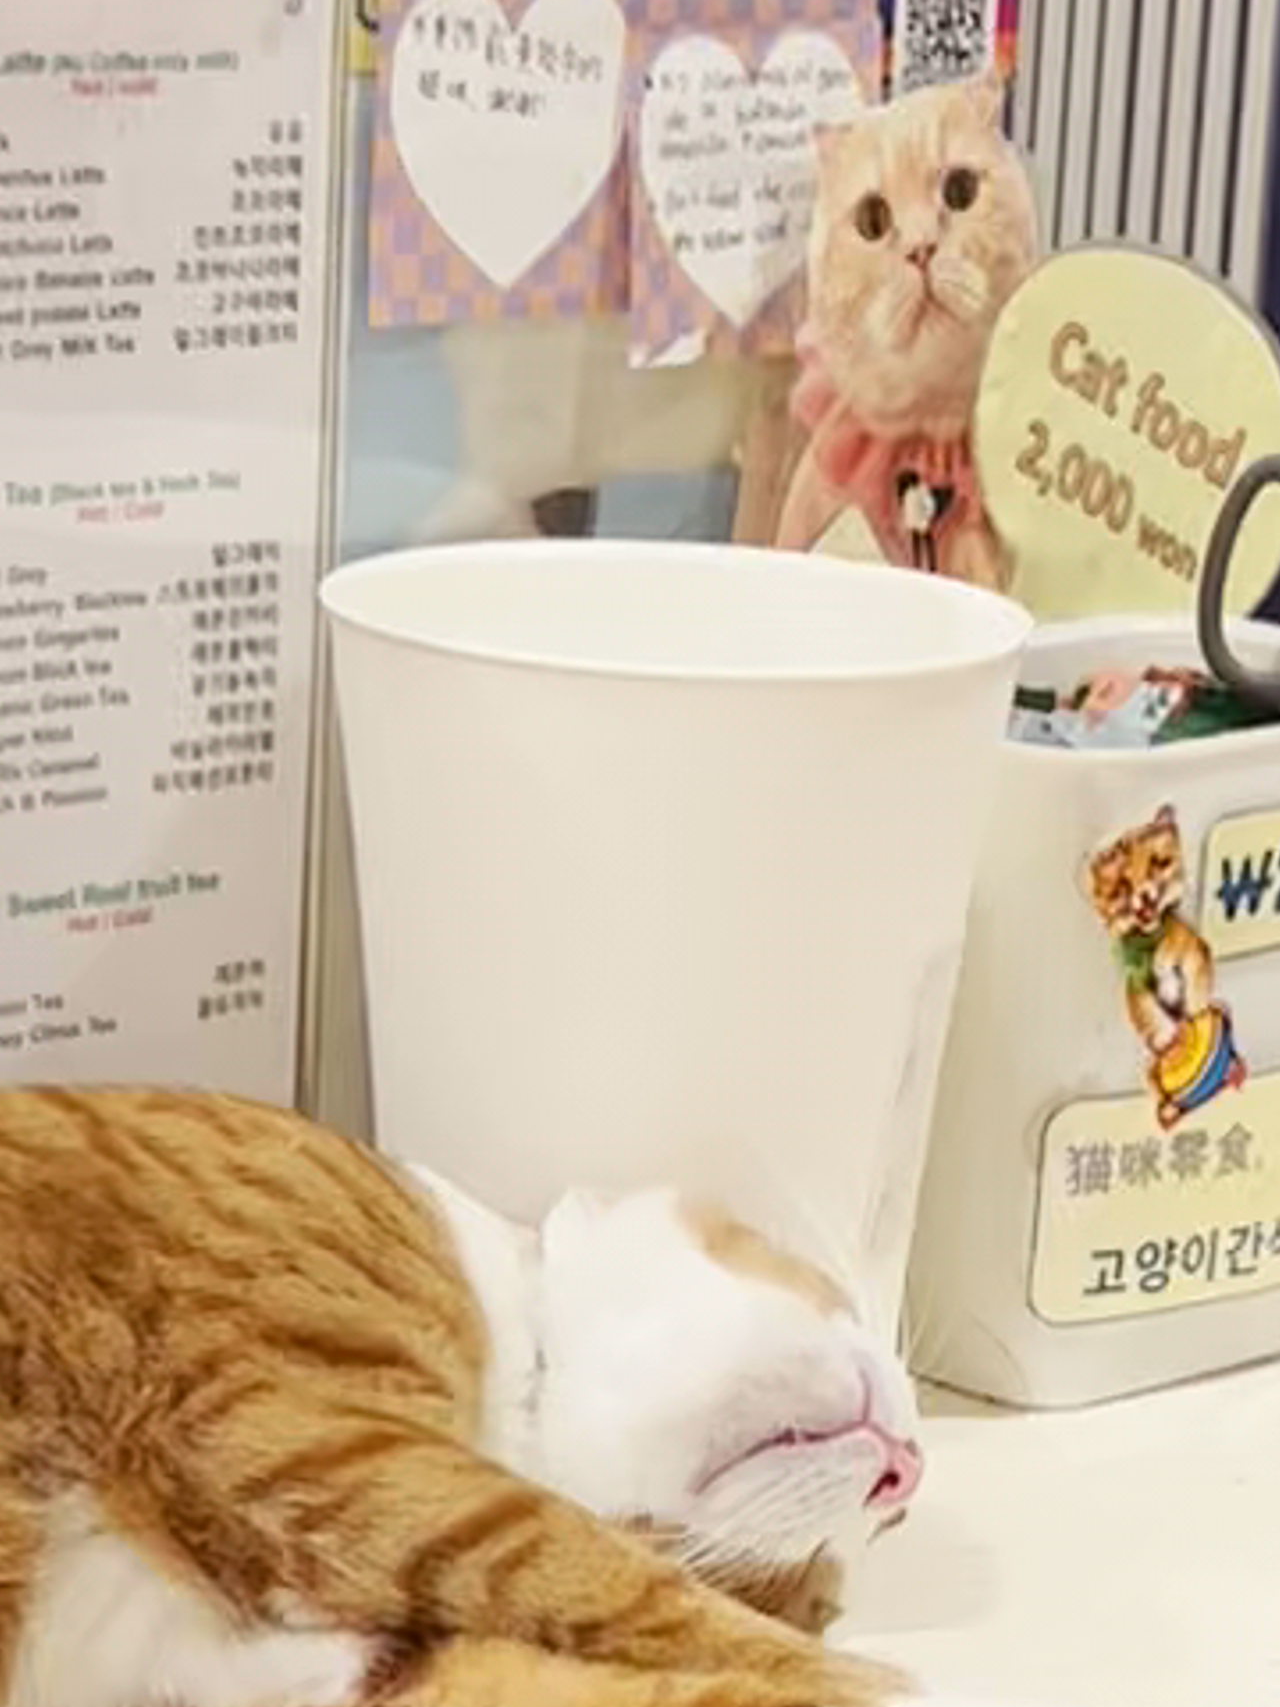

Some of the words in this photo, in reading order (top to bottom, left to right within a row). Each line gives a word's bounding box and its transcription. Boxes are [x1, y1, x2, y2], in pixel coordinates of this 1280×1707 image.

[33, 202, 81, 222] Latte
[60, 166, 106, 185] Latte
[1050, 321, 1128, 419] Cat
[1130, 371, 1247, 492] food
[1015, 419, 1135, 534] 2,000
[1136, 513, 1197, 582] won
